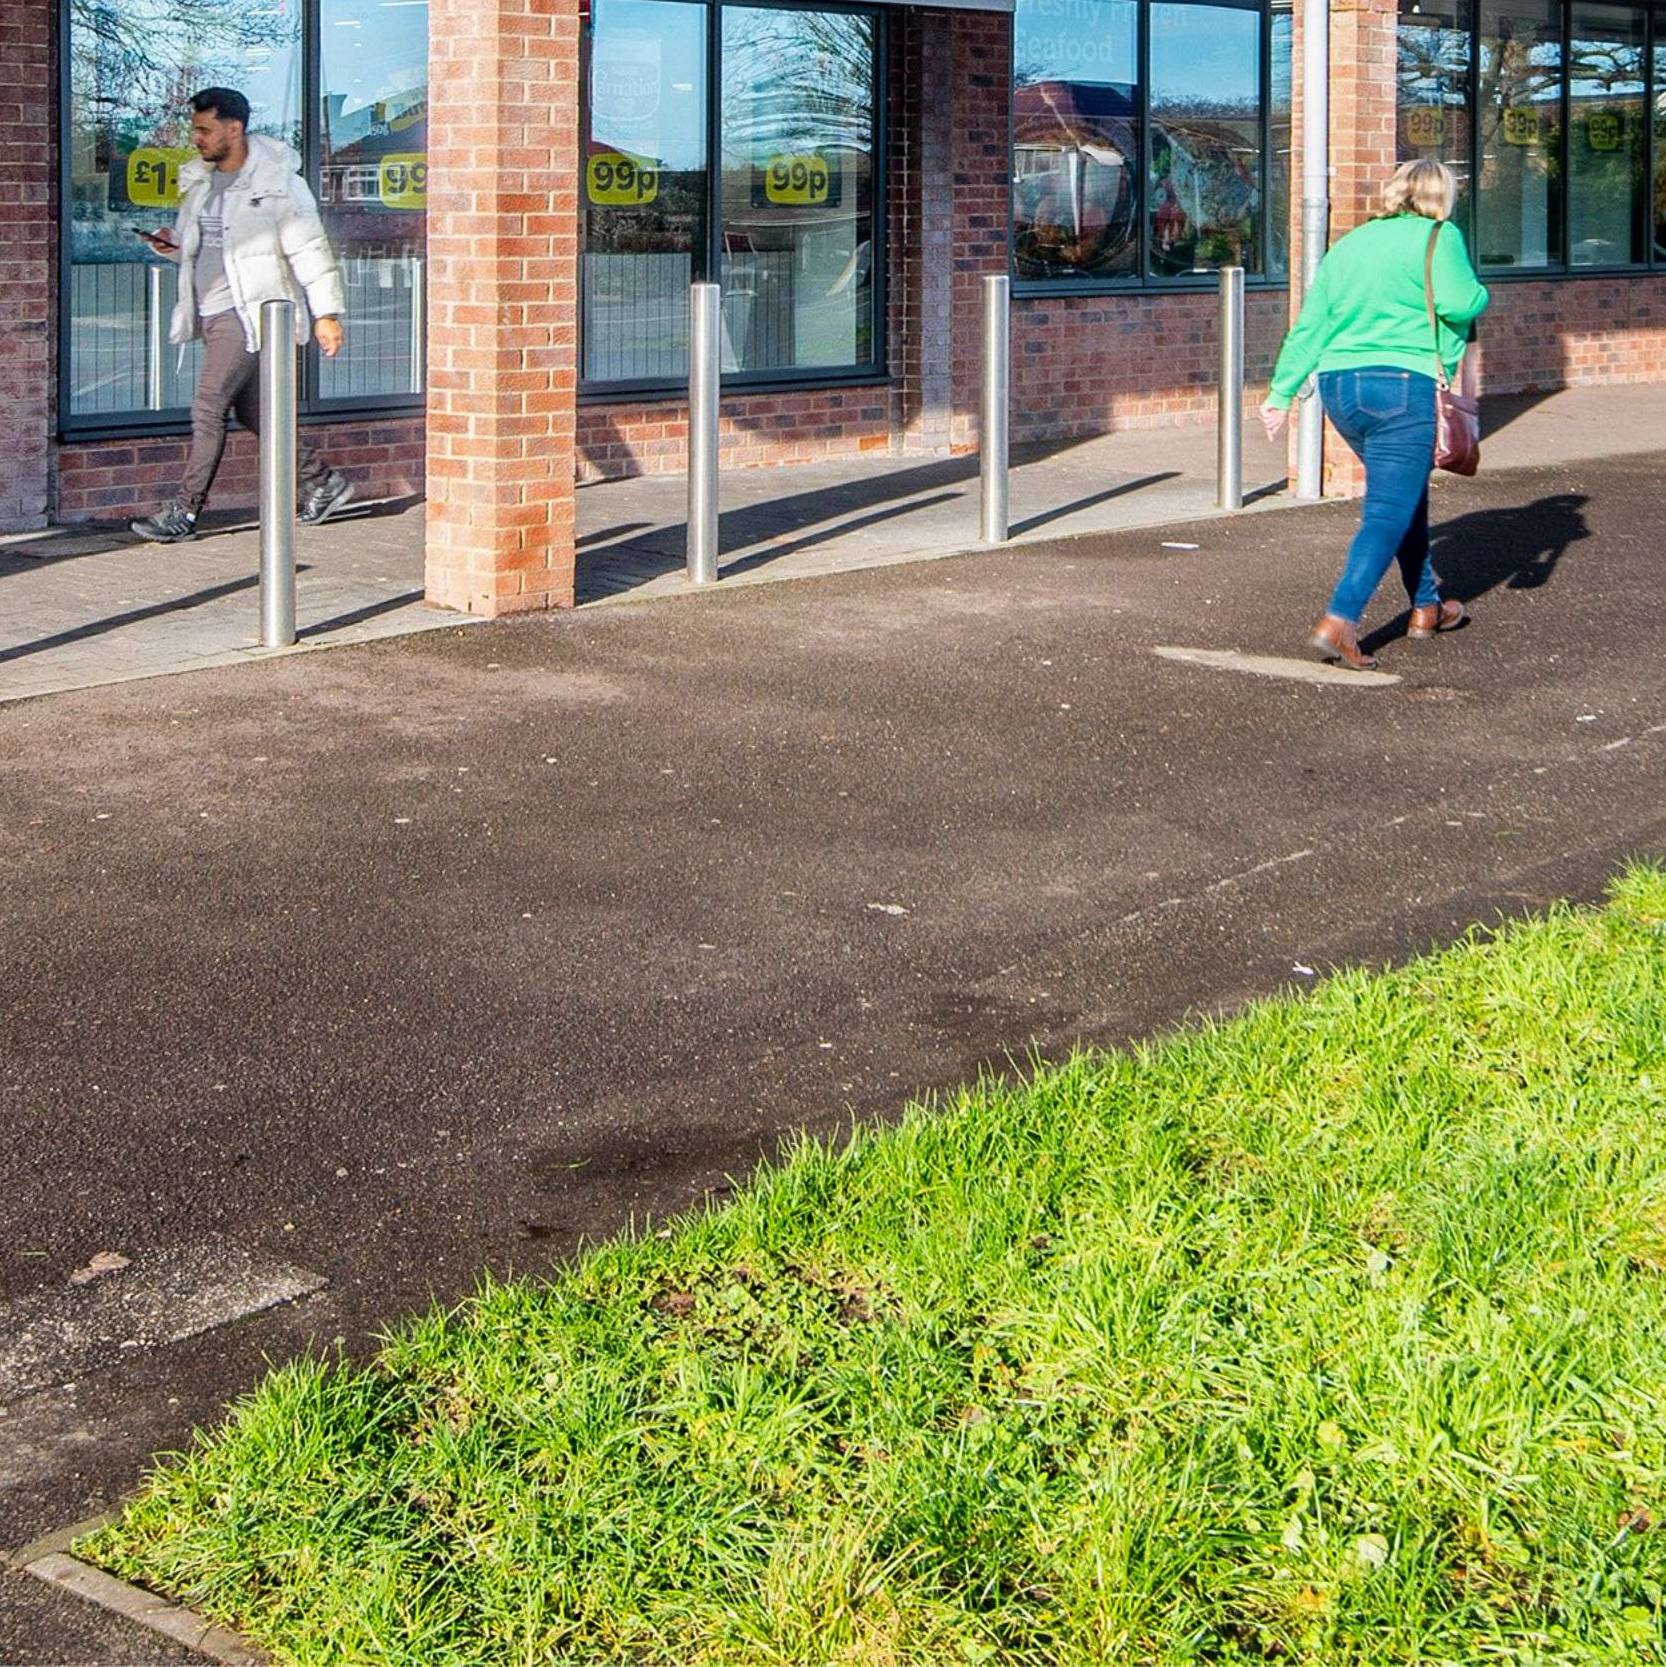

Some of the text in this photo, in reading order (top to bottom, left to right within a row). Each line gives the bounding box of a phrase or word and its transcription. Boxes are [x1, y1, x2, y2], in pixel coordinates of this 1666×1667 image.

[134, 160, 178, 196] £1.
[386, 162, 429, 195] 99
[594, 160, 656, 200] 99p
[772, 161, 827, 199] 99p
